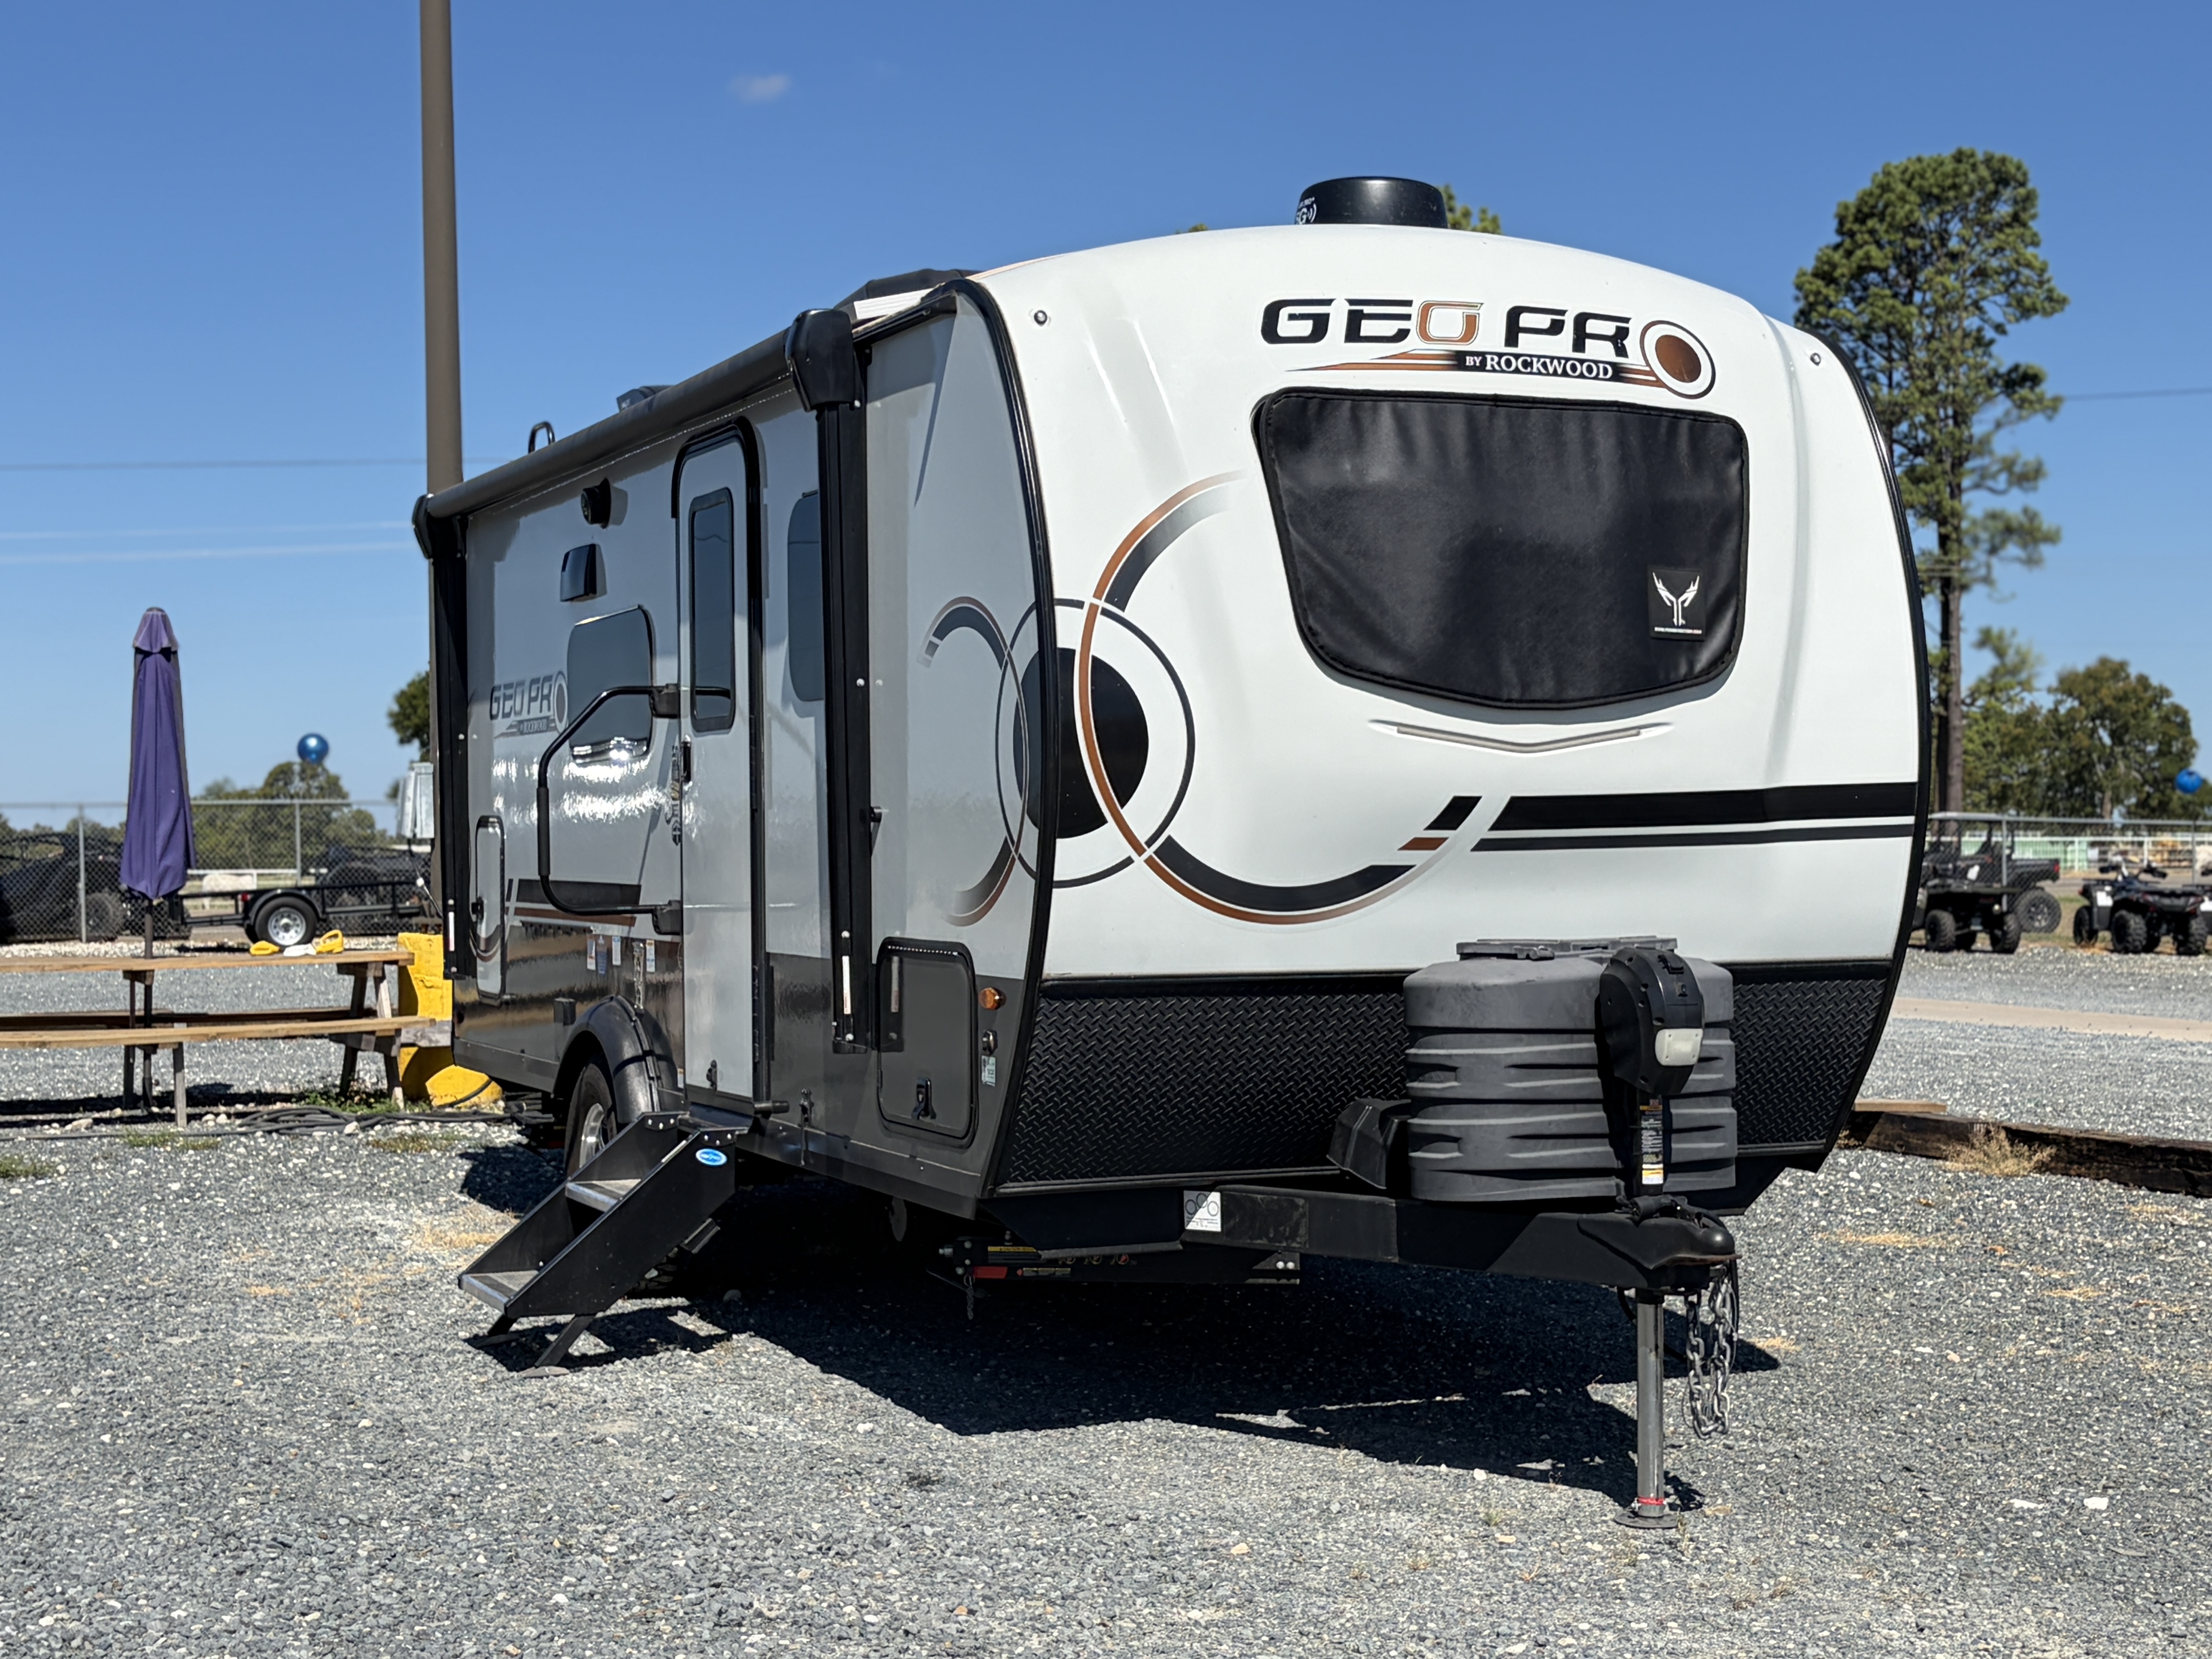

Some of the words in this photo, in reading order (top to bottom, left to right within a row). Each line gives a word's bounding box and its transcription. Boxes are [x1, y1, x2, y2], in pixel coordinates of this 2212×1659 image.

[1261, 298, 1484, 345] GEO
[1504, 305, 1716, 399] PRO
[1465, 356, 1481, 366] BY
[1485, 354, 1613, 379] ROCKWOOD
[490, 680, 526, 720] GEO
[527, 671, 568, 735] PRO
